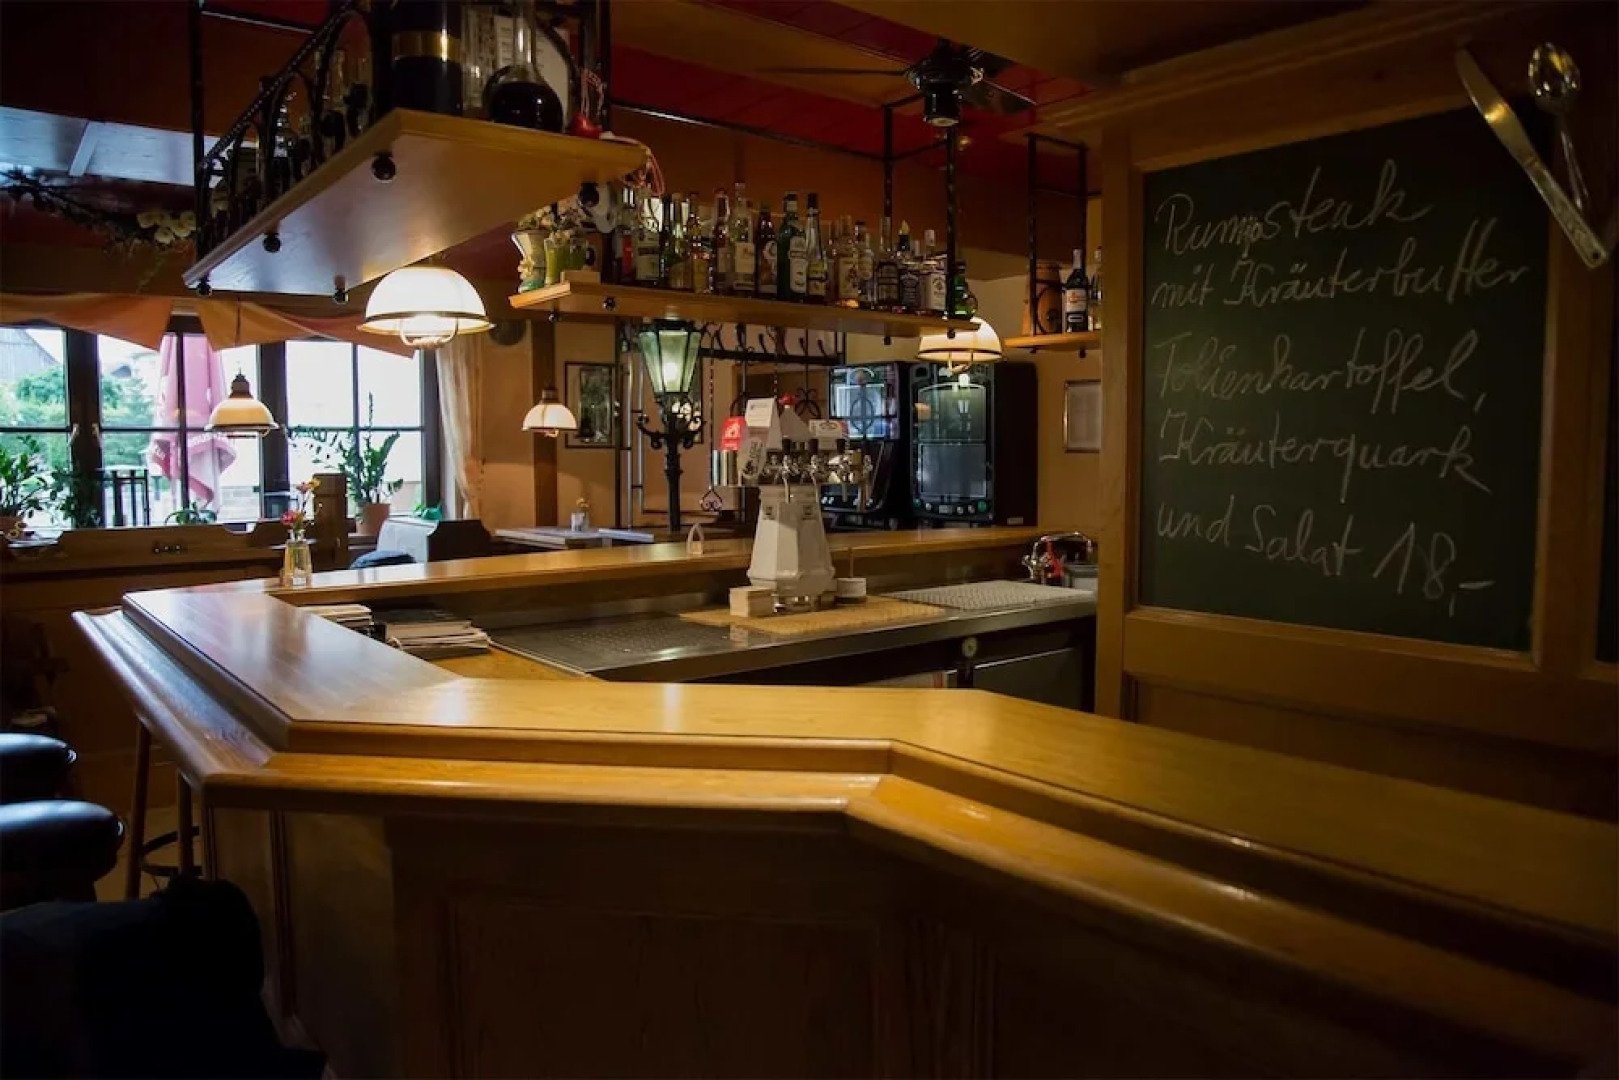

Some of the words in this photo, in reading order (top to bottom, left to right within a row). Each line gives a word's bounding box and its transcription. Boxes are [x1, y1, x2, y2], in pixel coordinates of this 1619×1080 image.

[1154, 158, 1434, 257] Rumpsteak
[1152, 264, 1214, 308] mit
[1223, 217, 1530, 304] Kräuterbutter
[1159, 408, 1492, 503] Kräuterquark
[1157, 494, 1234, 547] und
[1244, 505, 1360, 576] Salat
